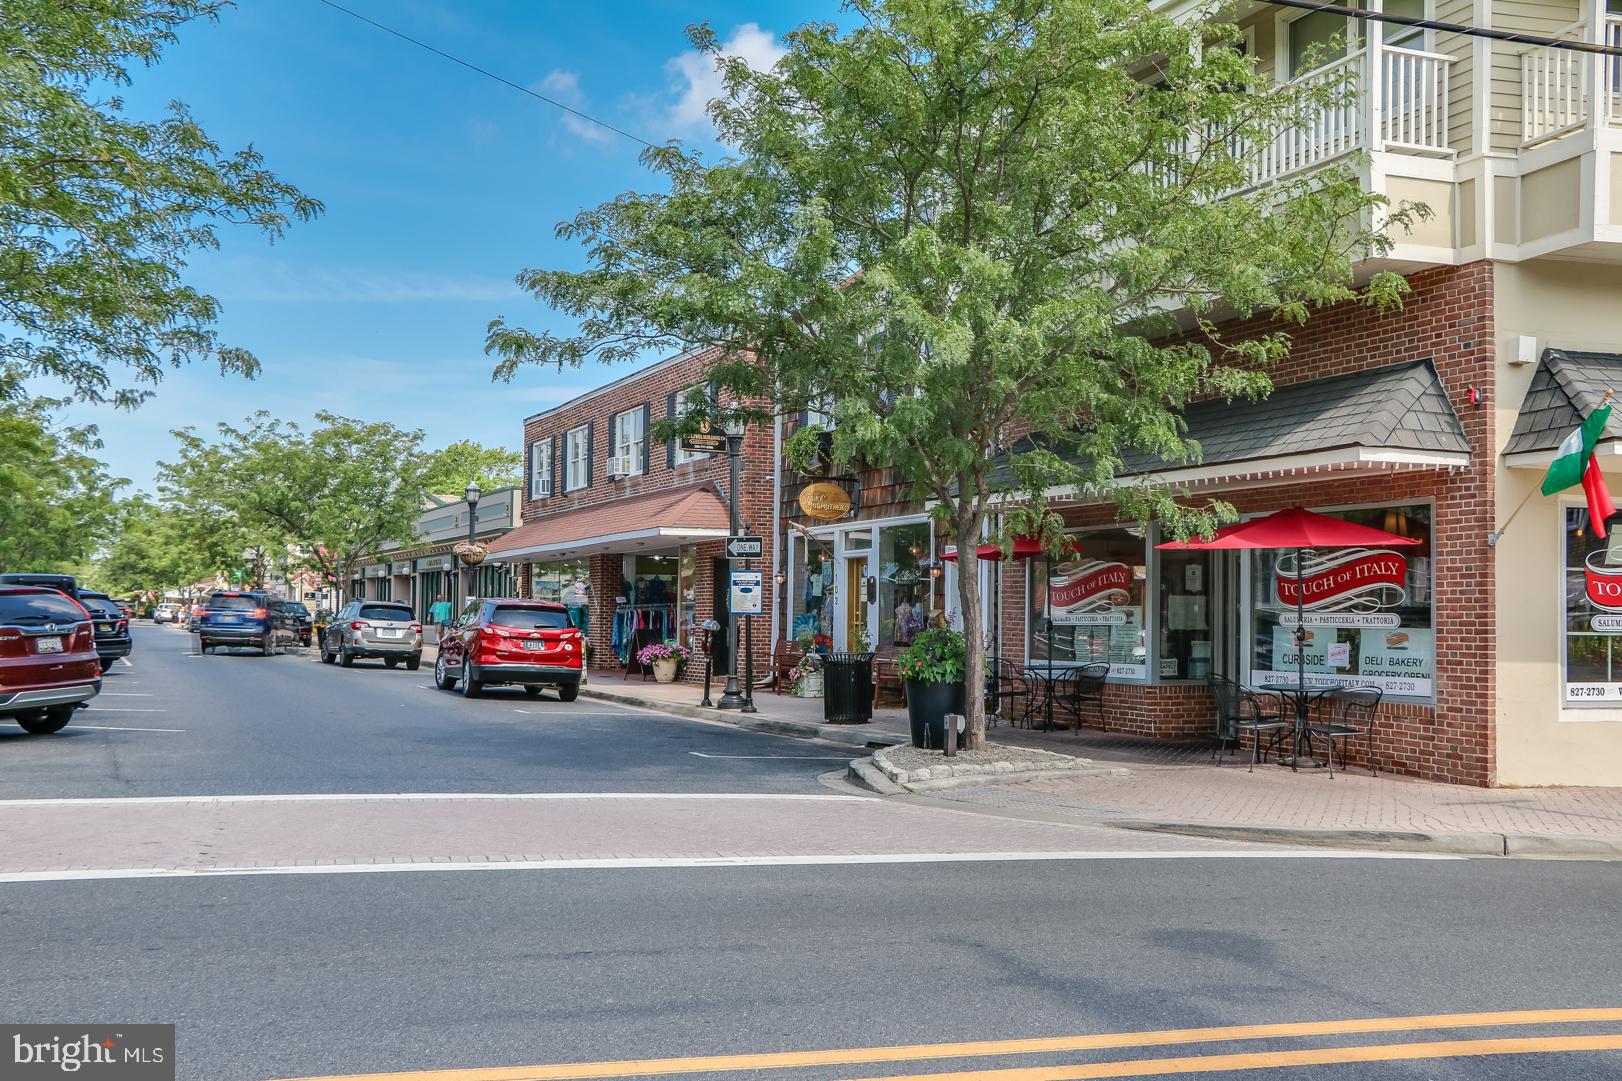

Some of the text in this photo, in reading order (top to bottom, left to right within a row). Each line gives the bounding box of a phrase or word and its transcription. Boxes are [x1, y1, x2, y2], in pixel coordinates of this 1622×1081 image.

[736, 543, 759, 552] ONE WAY
[1280, 561, 1400, 597] TOUCH OF ITALY
[1050, 571, 1126, 601] TOUCH OF ITALY
[1319, 616, 1355, 625] PASTICCERIA
[1361, 616, 1395, 625] TRATTORIA
[1364, 656, 1383, 666] DELI
[1388, 657, 1424, 668] BAKERY
[1264, 674, 1289, 684] 827-2730
[1385, 680, 1416, 692] 827-2730
[1570, 687, 1606, 697] 827-2730
